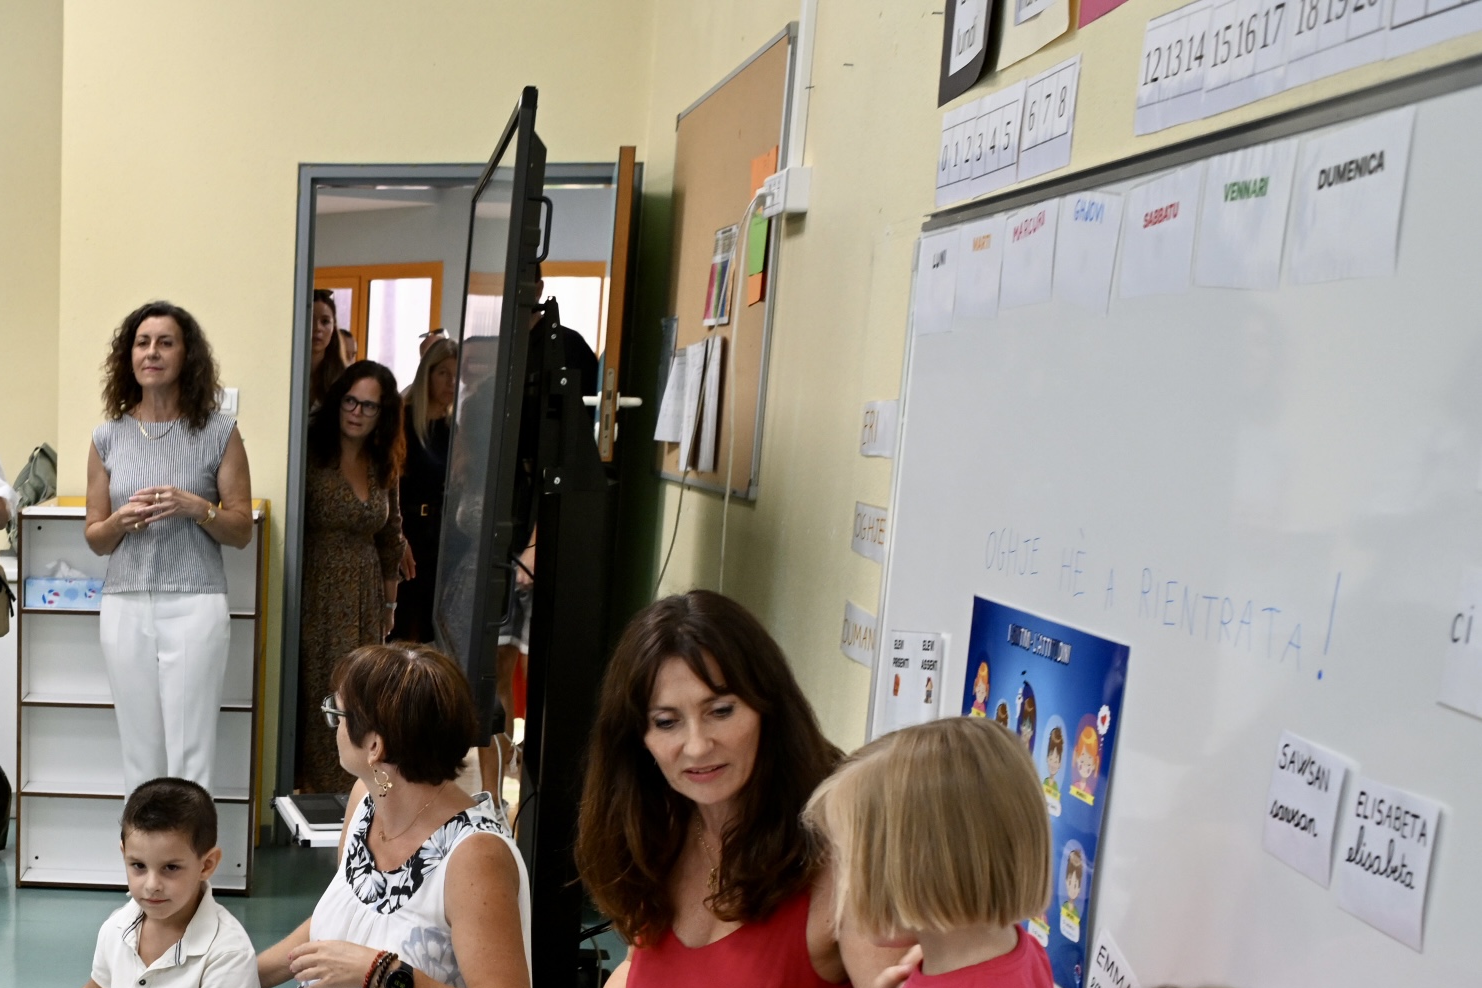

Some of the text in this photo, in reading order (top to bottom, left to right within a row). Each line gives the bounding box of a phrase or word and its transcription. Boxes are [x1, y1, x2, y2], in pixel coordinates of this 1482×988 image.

[1142, 47, 1161, 86] 12
[1164, 39, 1184, 79] 13
[1185, 28, 1205, 71] 14
[1211, 24, 1233, 68] 15
[1234, 13, 1257, 58] 16
[1260, 2, 1285, 49] 17
[1295, 0, 1319, 36] 18
[953, 140, 959, 168] 1
[964, 136, 972, 163] 2
[975, 133, 984, 161] 3
[989, 127, 997, 155] 4
[1003, 120, 1012, 151] 5
[1028, 100, 1036, 132] 6
[1043, 92, 1052, 125] 7
[1058, 85, 1067, 118] 8
[1224, 176, 1269, 202] VENNARI
[1317, 150, 1385, 191] DUMENICA
[1143, 201, 1180, 229] SABBATU
[985, 528, 1040, 577] OGHJE
[1104, 567, 1114, 611] A
[1278, 743, 1330, 793] SAWSAN
[1356, 790, 1427, 847] ELISABETA
[1345, 824, 1415, 890] elisabeta
